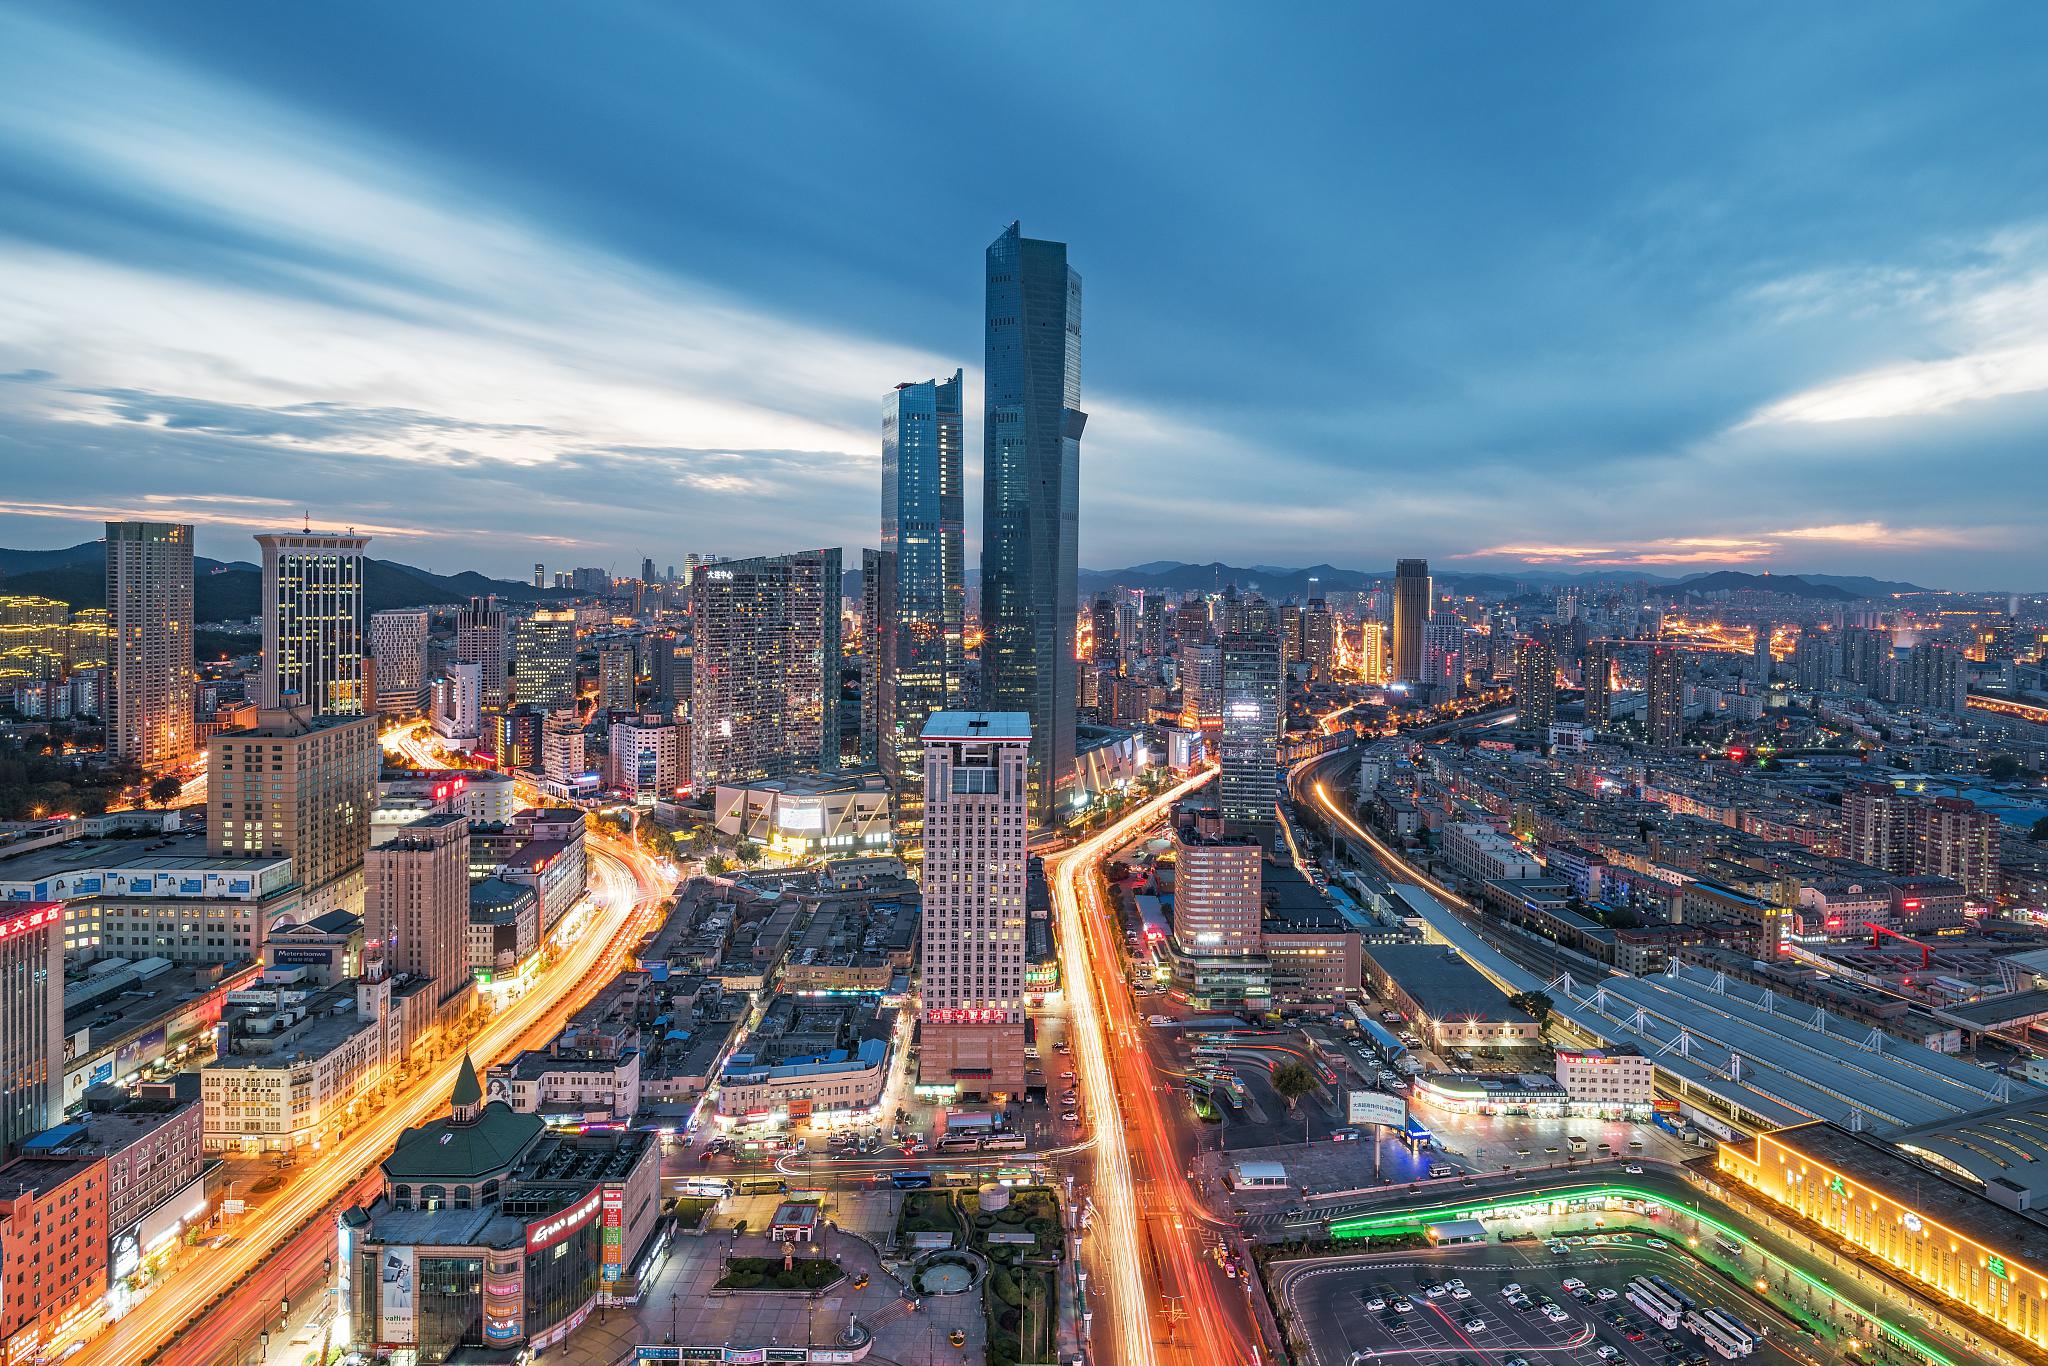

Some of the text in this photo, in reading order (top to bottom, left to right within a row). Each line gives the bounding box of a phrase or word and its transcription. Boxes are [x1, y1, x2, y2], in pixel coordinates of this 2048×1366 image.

[707, 570, 733, 579] 大连中心
[1831, 1175, 1846, 1197] 大
